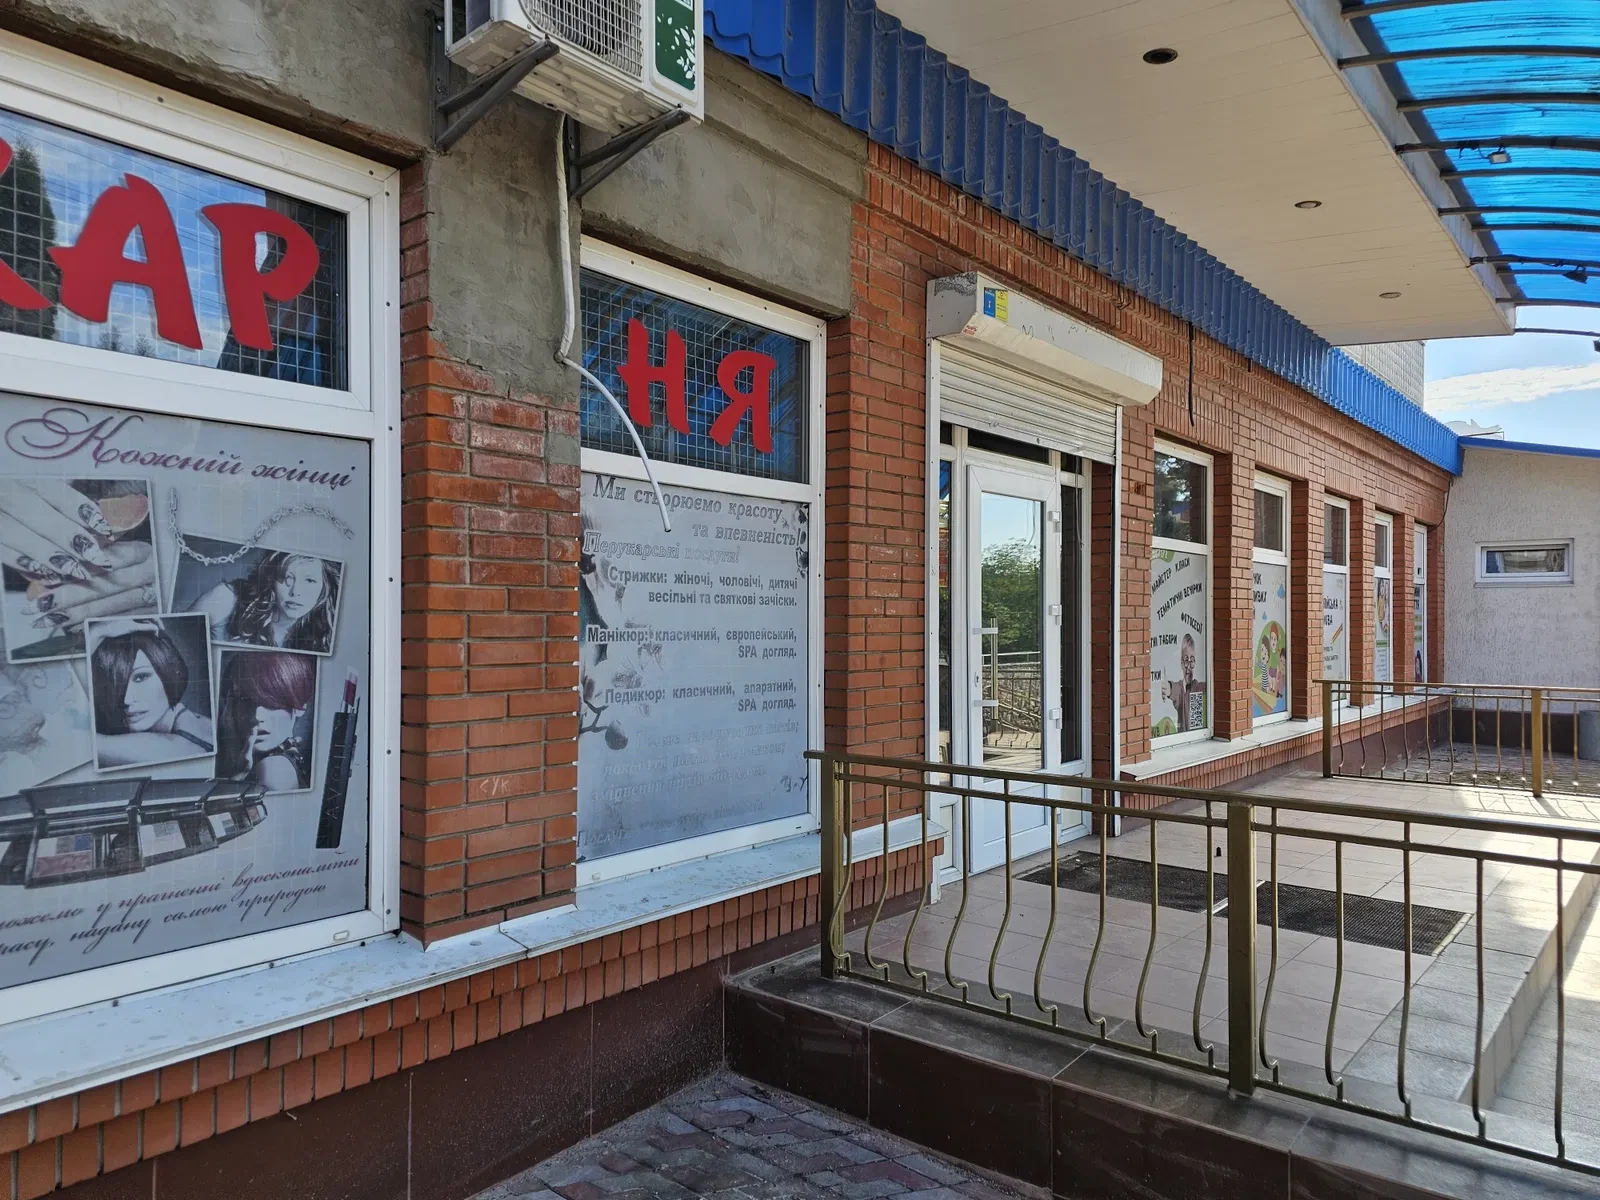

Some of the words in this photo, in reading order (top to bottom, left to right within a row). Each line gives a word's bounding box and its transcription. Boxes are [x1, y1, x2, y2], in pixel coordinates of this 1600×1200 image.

[251, 459, 356, 490] жінці
[593, 475, 626, 500] Ми
[693, 524, 709, 538] та
[584, 531, 680, 559] Перукарські
[608, 566, 668, 584] Стрижки:
[674, 571, 714, 589] жіночі,
[719, 574, 764, 591] чоловічі,
[768, 577, 798, 591] дитячі
[648, 590, 697, 604] весільні
[699, 593, 711, 604] та
[714, 593, 756, 605] святкові
[759, 594, 797, 607] зачіски.
[588, 626, 649, 645] Манікюр:
[655, 628, 720, 643] класичний,
[726, 628, 797, 643] європейський,
[738, 645, 757, 658] SPA
[762, 645, 797, 660] догляд.
[605, 688, 666, 704] Педикюр:
[672, 681, 735, 699] класичний,
[744, 678, 797, 694] апаратний,
[738, 699, 757, 712] SPA
[762, 697, 797, 711] догляд.
[92, 902, 113, 928] у
[231, 858, 360, 902] вдосконалити
[69, 918, 152, 955] надану
[163, 903, 228, 923] самою
[238, 884, 327, 922] природою
